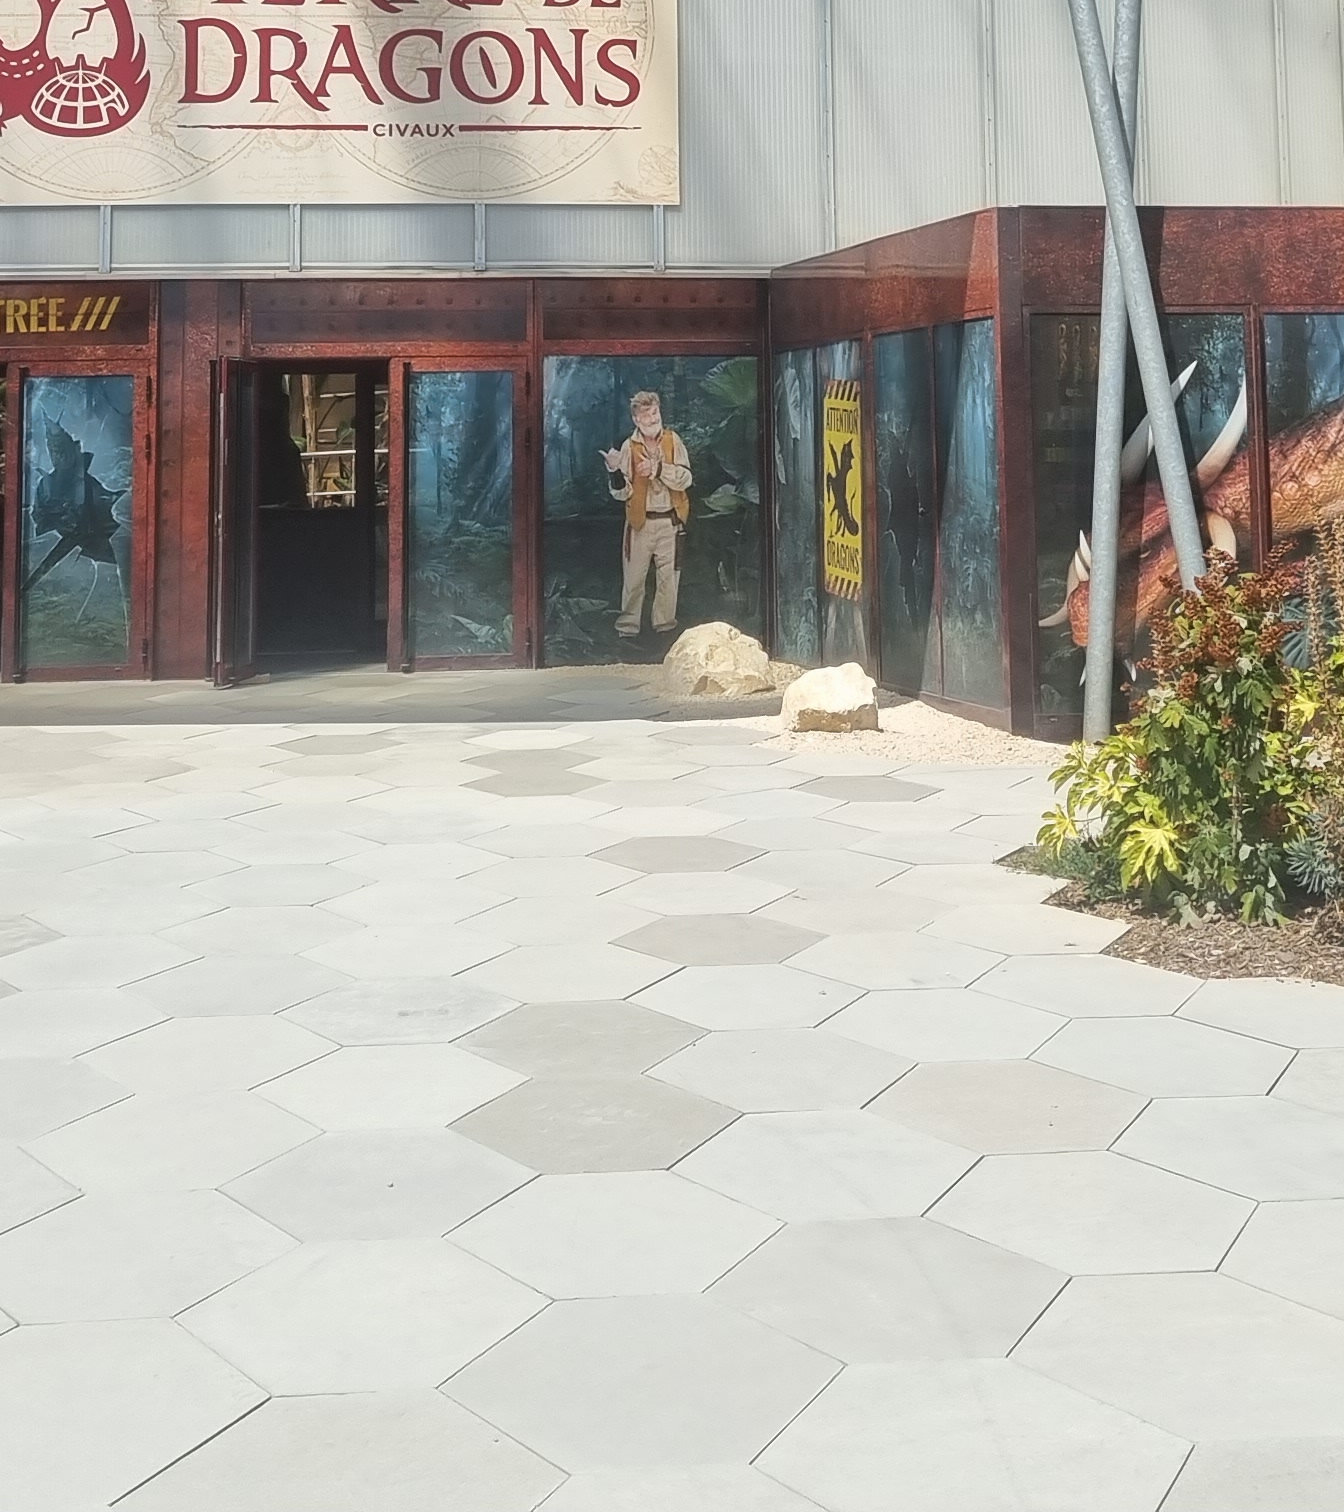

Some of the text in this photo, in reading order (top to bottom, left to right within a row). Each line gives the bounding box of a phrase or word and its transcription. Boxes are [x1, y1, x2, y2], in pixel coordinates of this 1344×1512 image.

[177, 17, 642, 112] DRAGONS
[372, 123, 456, 138] CIVAUX
[826, 407, 859, 436] ATTENTION
[826, 539, 860, 575] DRAGONS
